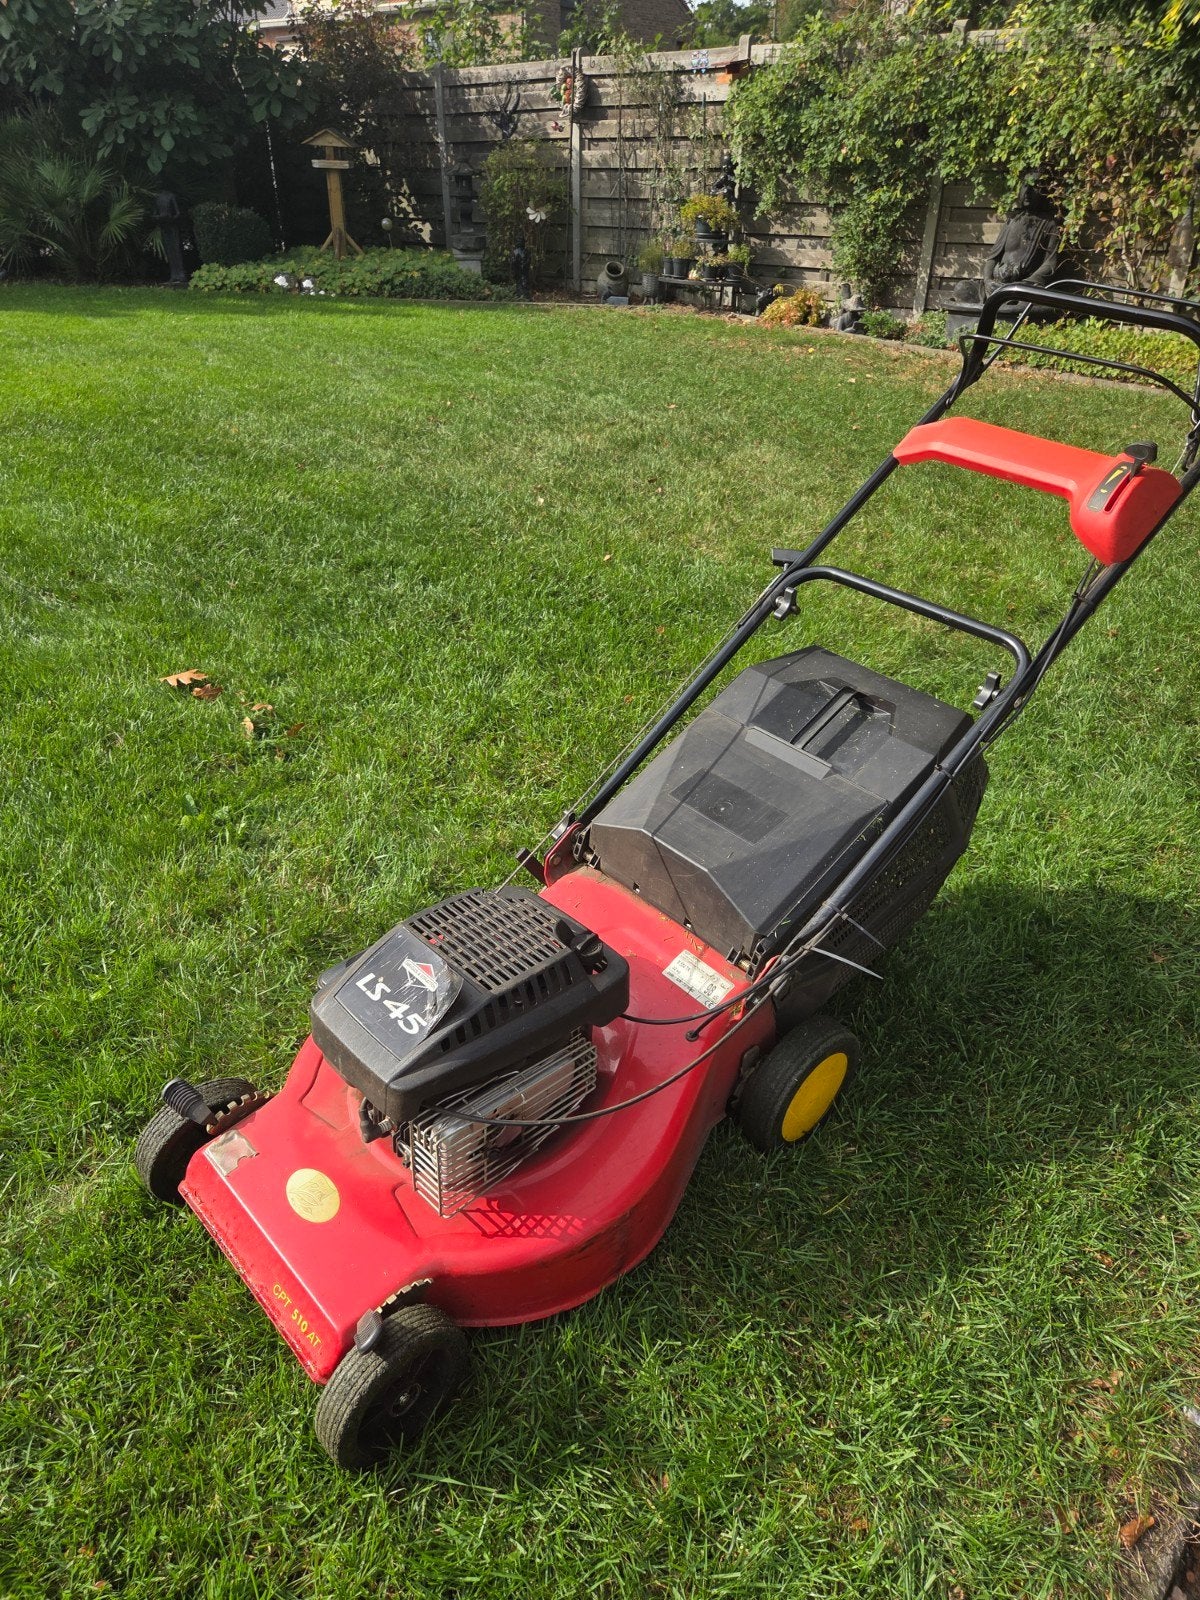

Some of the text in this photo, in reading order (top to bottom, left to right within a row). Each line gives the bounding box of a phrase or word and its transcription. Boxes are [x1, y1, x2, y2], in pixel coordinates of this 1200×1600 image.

[382, 999, 428, 1035] 45
[291, 1308, 308, 1332] 510
[306, 1332, 322, 1347] AT
